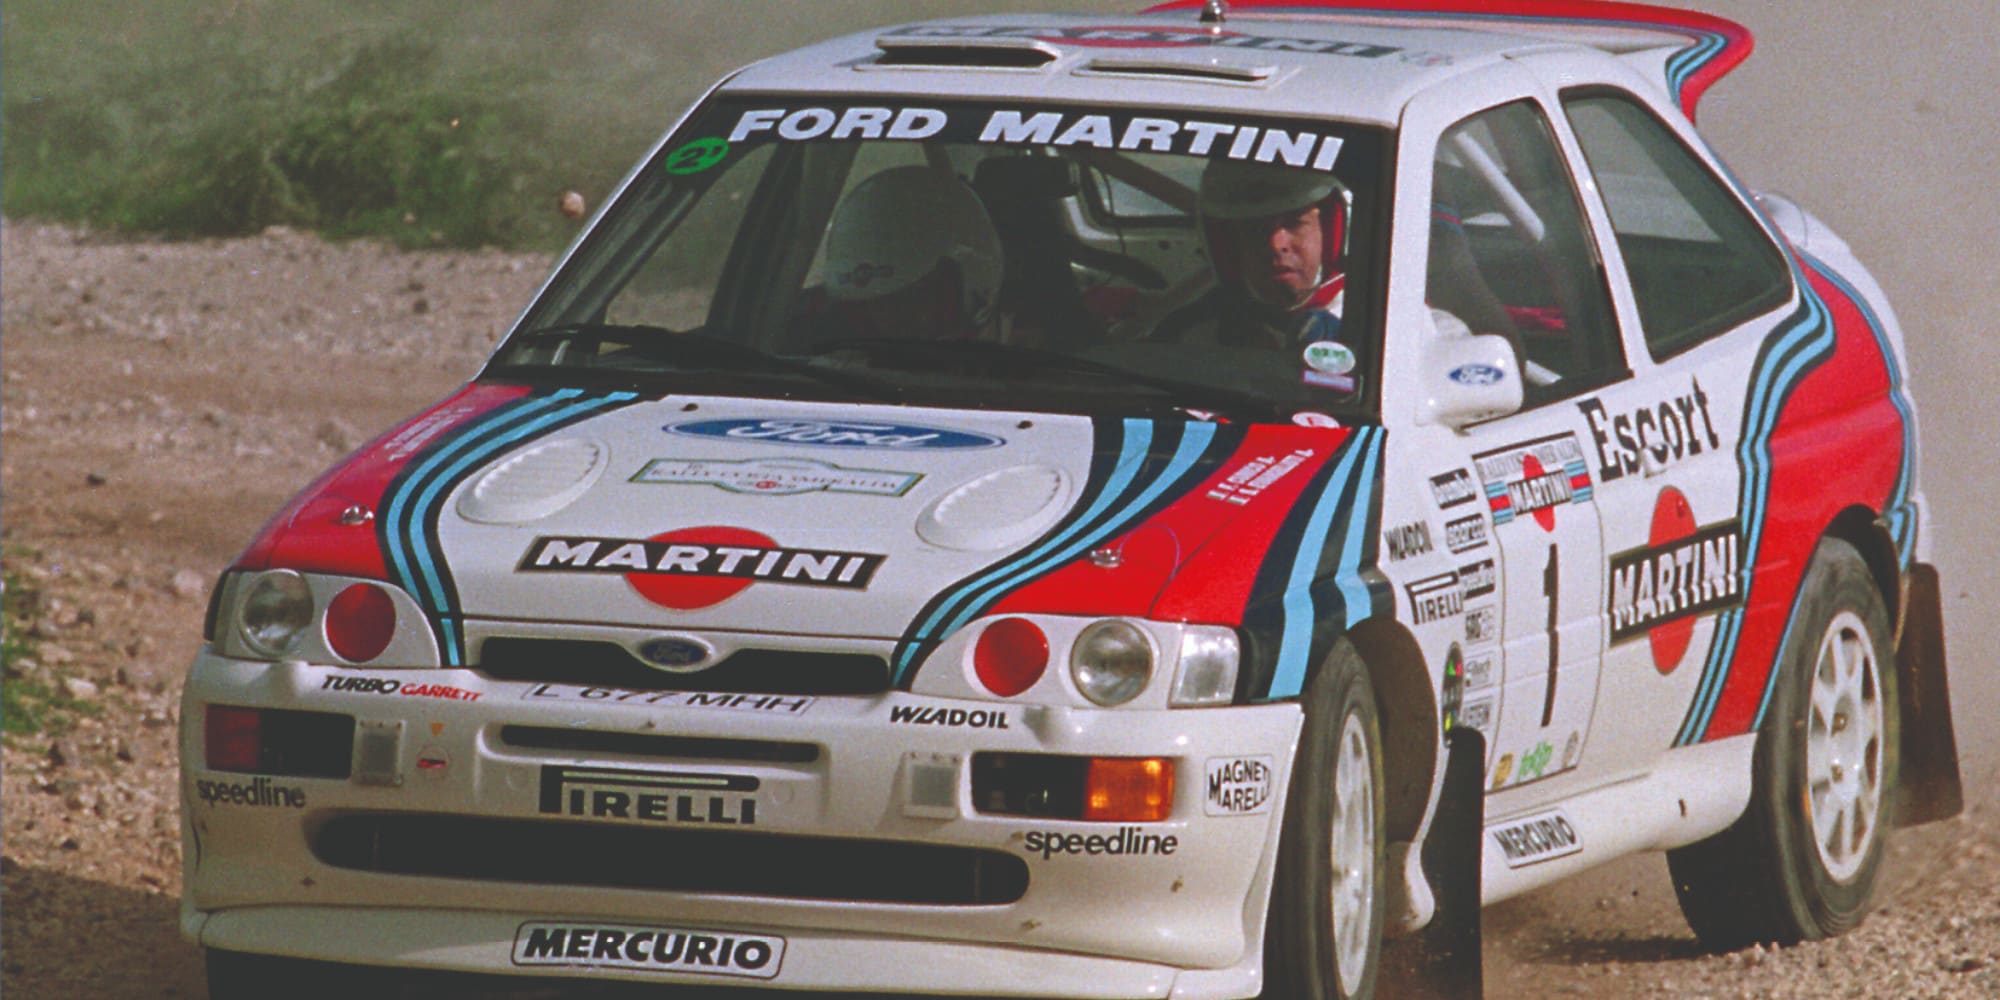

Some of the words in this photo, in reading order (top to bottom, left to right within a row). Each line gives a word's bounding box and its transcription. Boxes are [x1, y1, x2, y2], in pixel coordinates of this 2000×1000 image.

[728, 107, 947, 142] FORD
[979, 110, 1344, 172] MARTINI
[1459, 366, 1496, 383] Ford
[727, 420, 940, 446] Ford
[1577, 375, 1719, 482] Escort
[1510, 473, 1571, 514] MARTINI
[534, 540, 866, 582] MARTINI
[1404, 570, 1464, 625] PIRELLI
[1612, 534, 1737, 631] MARTINI
[1541, 543, 1559, 728] 1
[322, 675, 400, 694] TURBO
[400, 682, 484, 702] GARRETT
[533, 684, 559, 697] L
[686, 693, 806, 712] MHH
[197, 778, 306, 808] speedline
[539, 764, 760, 824] PIRELLI
[1025, 827, 1178, 860] speedline
[1493, 815, 1576, 860] MERCURIO
[523, 928, 771, 969] MERCURIO
